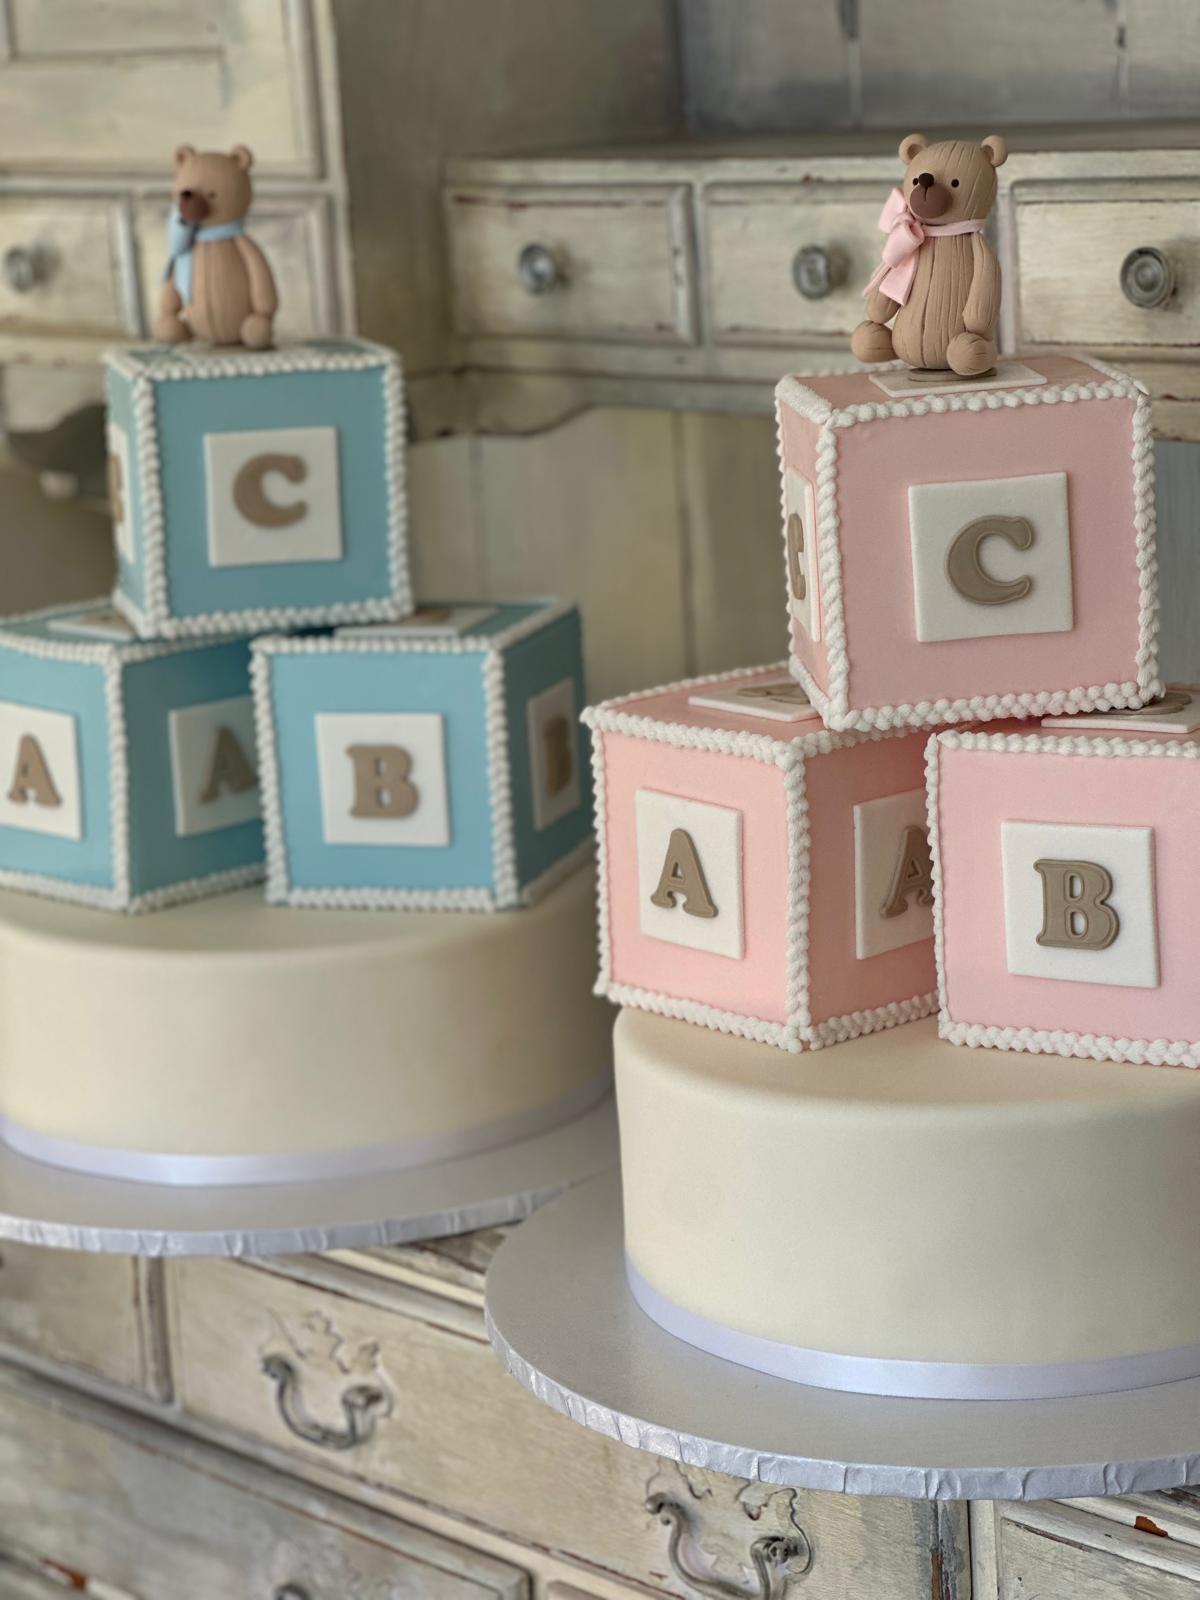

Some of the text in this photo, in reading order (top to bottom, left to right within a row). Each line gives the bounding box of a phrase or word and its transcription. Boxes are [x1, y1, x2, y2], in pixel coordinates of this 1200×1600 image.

[233, 453, 309, 528] C
[944, 515, 1034, 605] C
[8, 733, 63, 808] A
[198, 725, 260, 805] A
[346, 743, 420, 820] B
[650, 828, 719, 919] A
[879, 825, 935, 919] A
[1033, 858, 1120, 951] B
